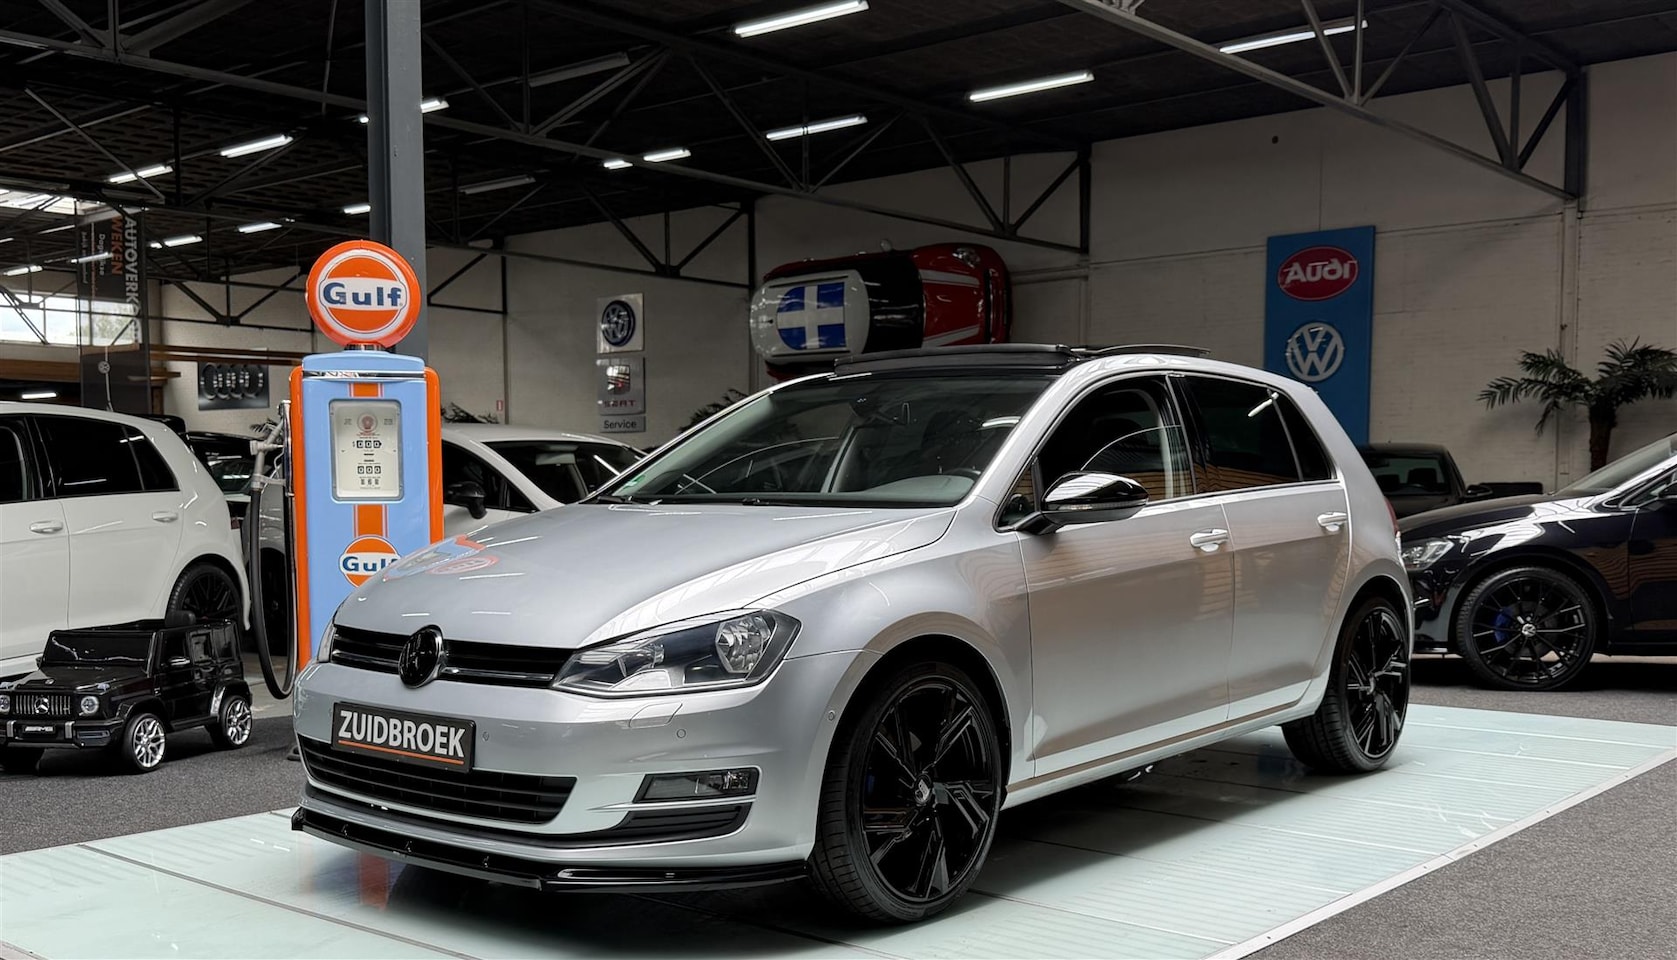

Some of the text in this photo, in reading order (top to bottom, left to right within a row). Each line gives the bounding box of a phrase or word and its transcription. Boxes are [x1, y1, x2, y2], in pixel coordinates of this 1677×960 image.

[112, 215, 123, 275] WEKEN
[322, 282, 402, 307] Gulf
[603, 420, 637, 429] Service
[338, 710, 465, 758] ZUIDBROEK
